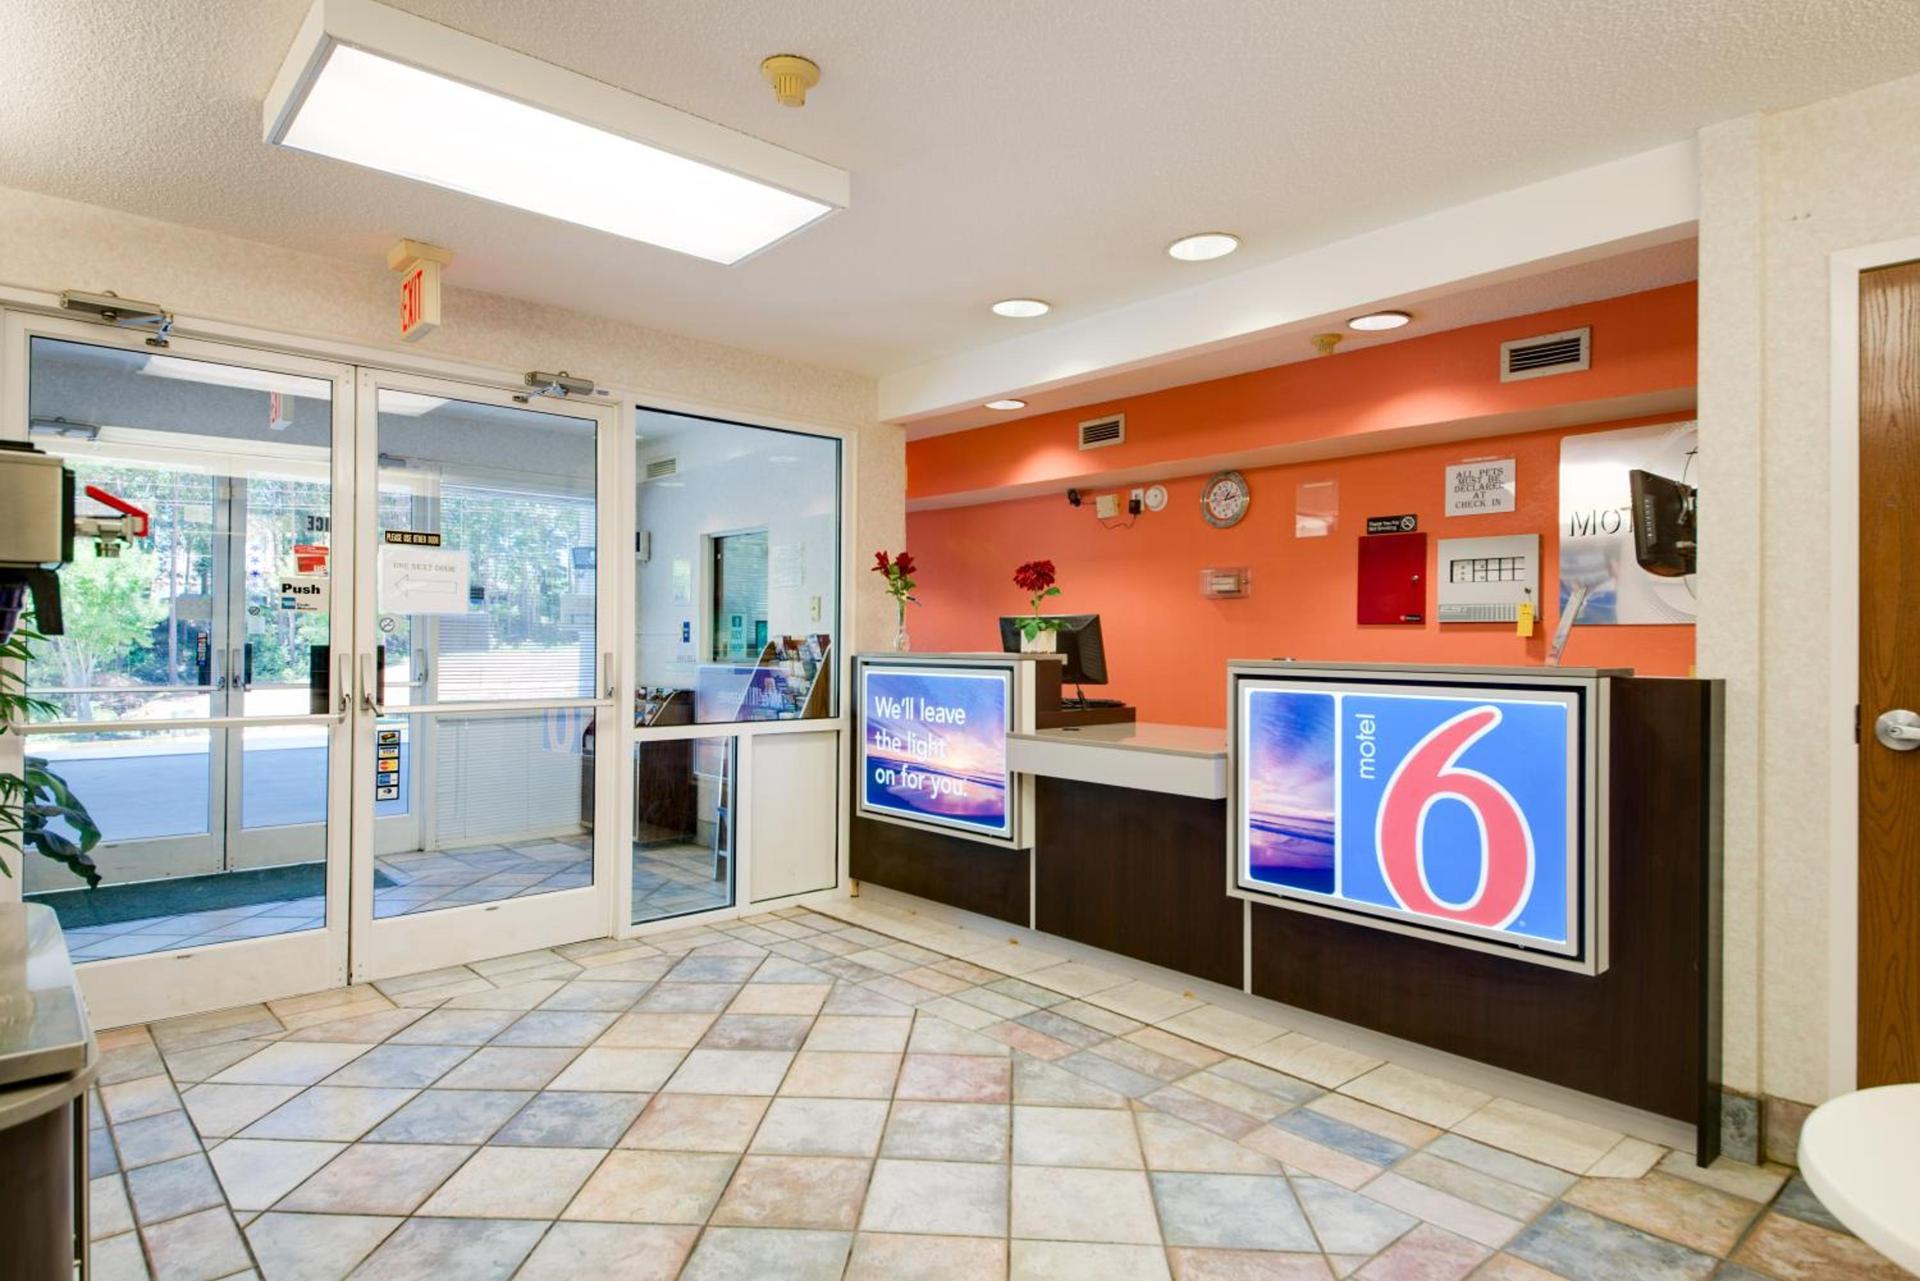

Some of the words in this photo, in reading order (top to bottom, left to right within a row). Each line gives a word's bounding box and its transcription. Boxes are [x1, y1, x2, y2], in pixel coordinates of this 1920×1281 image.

[402, 269, 423, 334] EXIT
[1455, 470, 1473, 479] ALL
[1478, 467, 1504, 478] PETS
[1458, 475, 1482, 485] MUST
[1487, 474, 1501, 483] BE
[1473, 491, 1487, 499] AT
[1455, 500, 1486, 509] CHECK
[1491, 498, 1502, 506] IN
[386, 533, 402, 542] PLEASE
[403, 534, 412, 543] USE
[281, 583, 321, 594] Push
[874, 696, 914, 721] We'll
[920, 697, 966, 725] leave
[874, 729, 902, 752] the
[907, 731, 946, 761] light
[874, 767, 896, 786] on
[900, 763, 926, 790] for
[929, 775, 968, 799] you.
[1355, 713, 1377, 780] motel
[1375, 705, 1536, 930] 6
